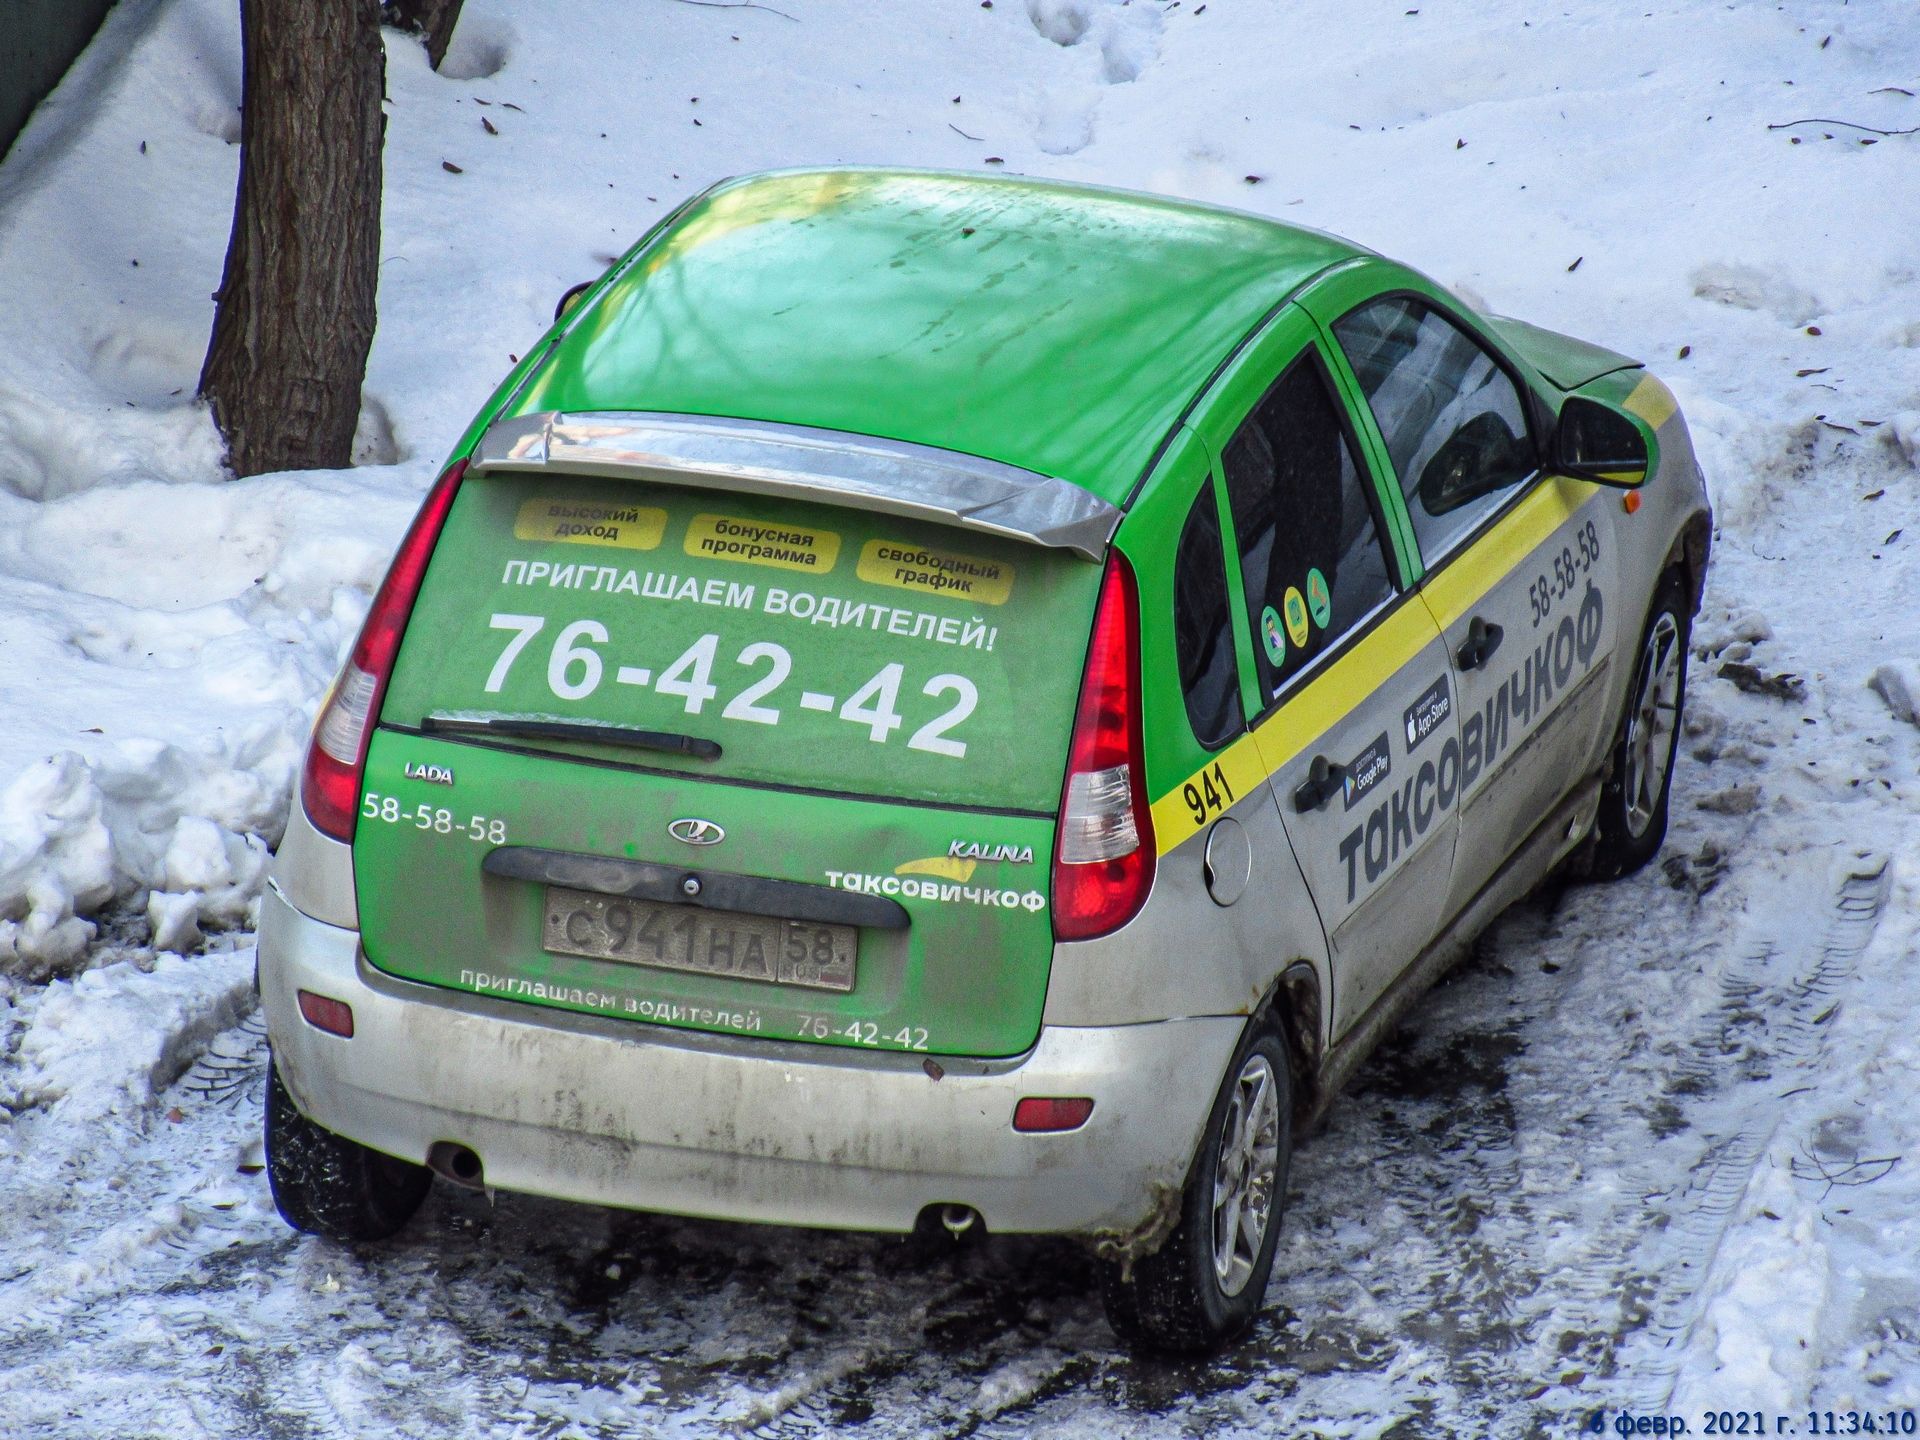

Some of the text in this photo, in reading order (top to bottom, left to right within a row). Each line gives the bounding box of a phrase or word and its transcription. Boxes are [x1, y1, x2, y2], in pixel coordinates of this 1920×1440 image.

[547, 505, 640, 523] высокий
[555, 523, 619, 541] доход
[714, 519, 814, 547] бонусная
[701, 536, 817, 566] программа
[877, 547, 1000, 581] свободный
[894, 566, 974, 593] график
[1530, 520, 1600, 629] 58-58-58
[501, 560, 999, 651] ПРИГЛАШАЕМ ВОДИТЕЛЕЙ!
[484, 613, 980, 758] 76-42-42
[1418, 714, 1432, 736] App
[1431, 697, 1449, 723] Store
[404, 761, 454, 786] LADA
[1357, 763, 1377, 790] Google
[1376, 755, 1389, 774] Play
[1183, 762, 1234, 825] 941
[362, 792, 507, 845] 58-58-58
[948, 839, 1035, 863] KALINA
[460, 969, 929, 1050] приглашаем водителей 76-42-42
